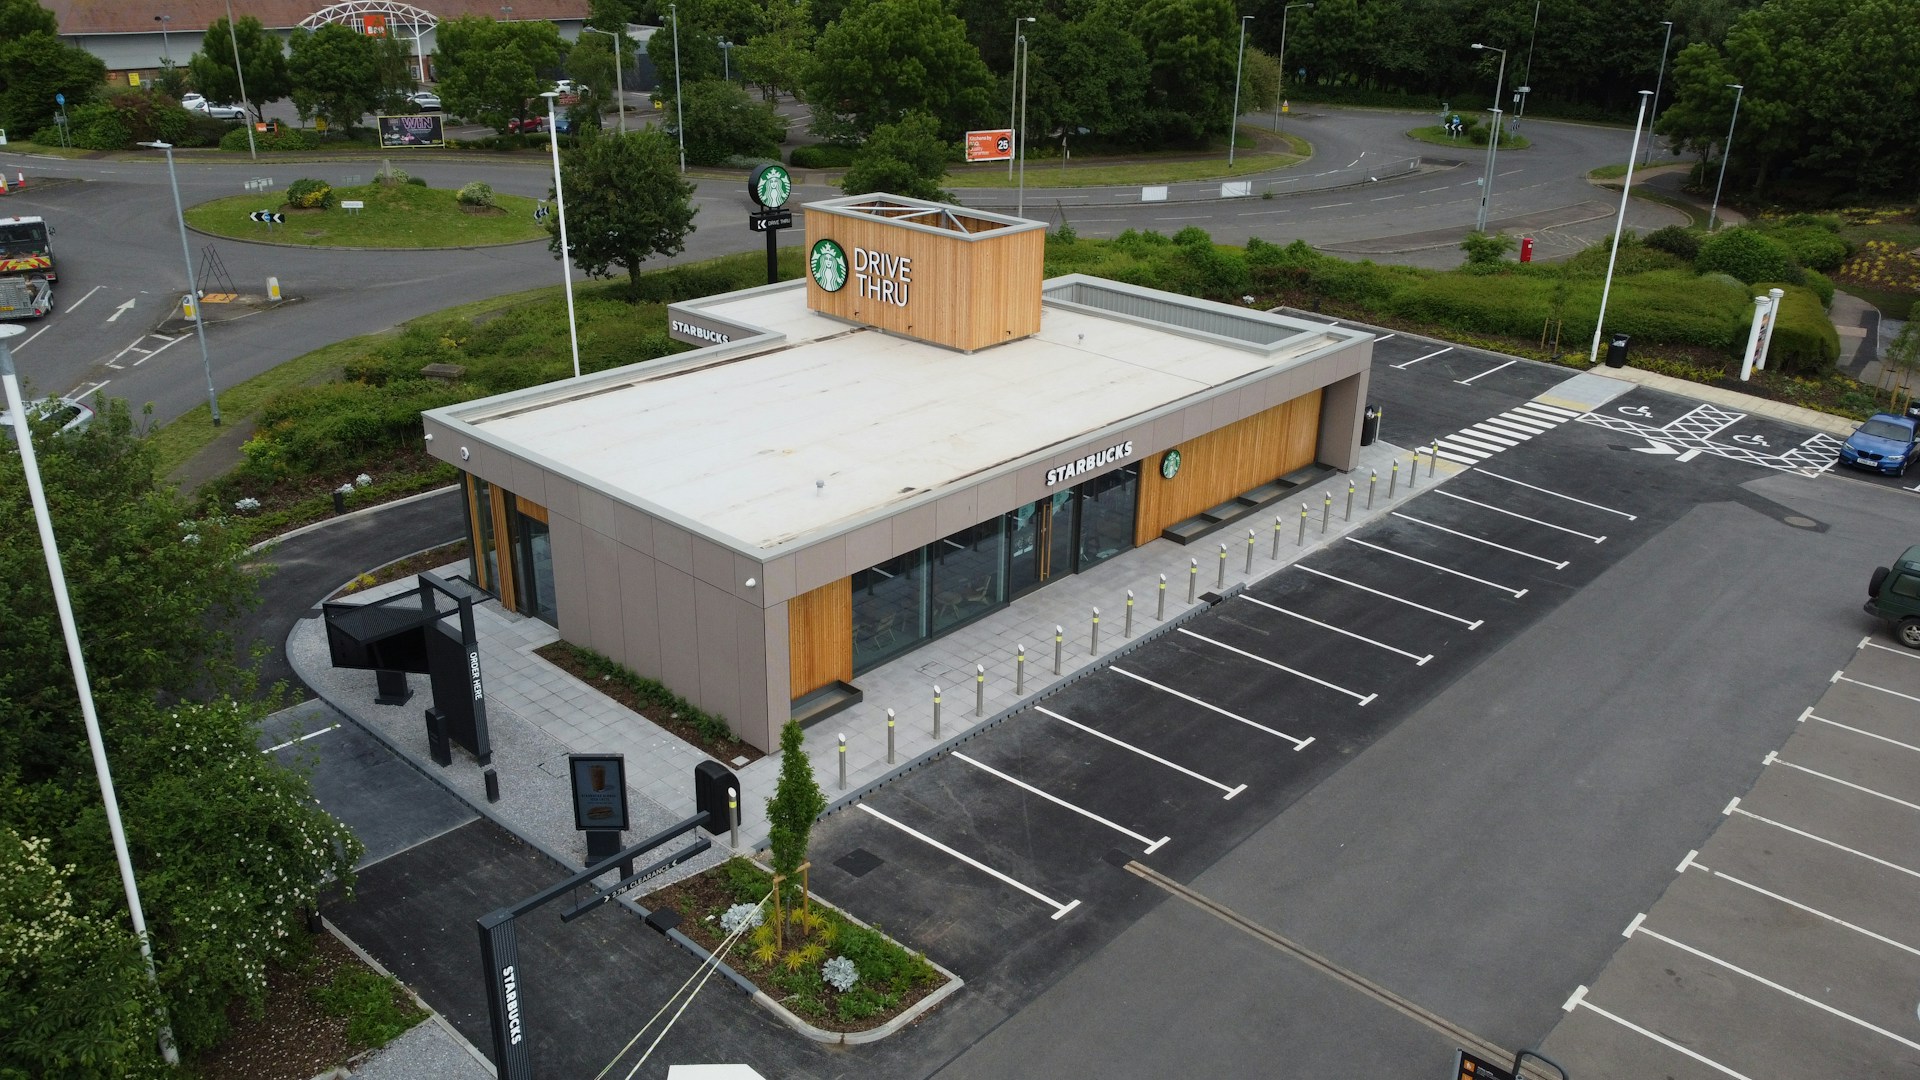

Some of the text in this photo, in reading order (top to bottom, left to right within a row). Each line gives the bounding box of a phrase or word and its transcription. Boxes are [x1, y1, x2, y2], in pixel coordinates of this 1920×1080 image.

[401, 117, 433, 129] WIN
[998, 140, 1009, 150] 25
[854, 247, 912, 283] DRIVE
[855, 273, 909, 307] THRU
[672, 320, 730, 345] STARBUCKS
[1046, 440, 1133, 486] STARBUCKS
[469, 652, 483, 701] ORDER HERE
[611, 863, 670, 899] 2.7M CLEARANCE
[502, 965, 522, 1045] STARBUCKS
